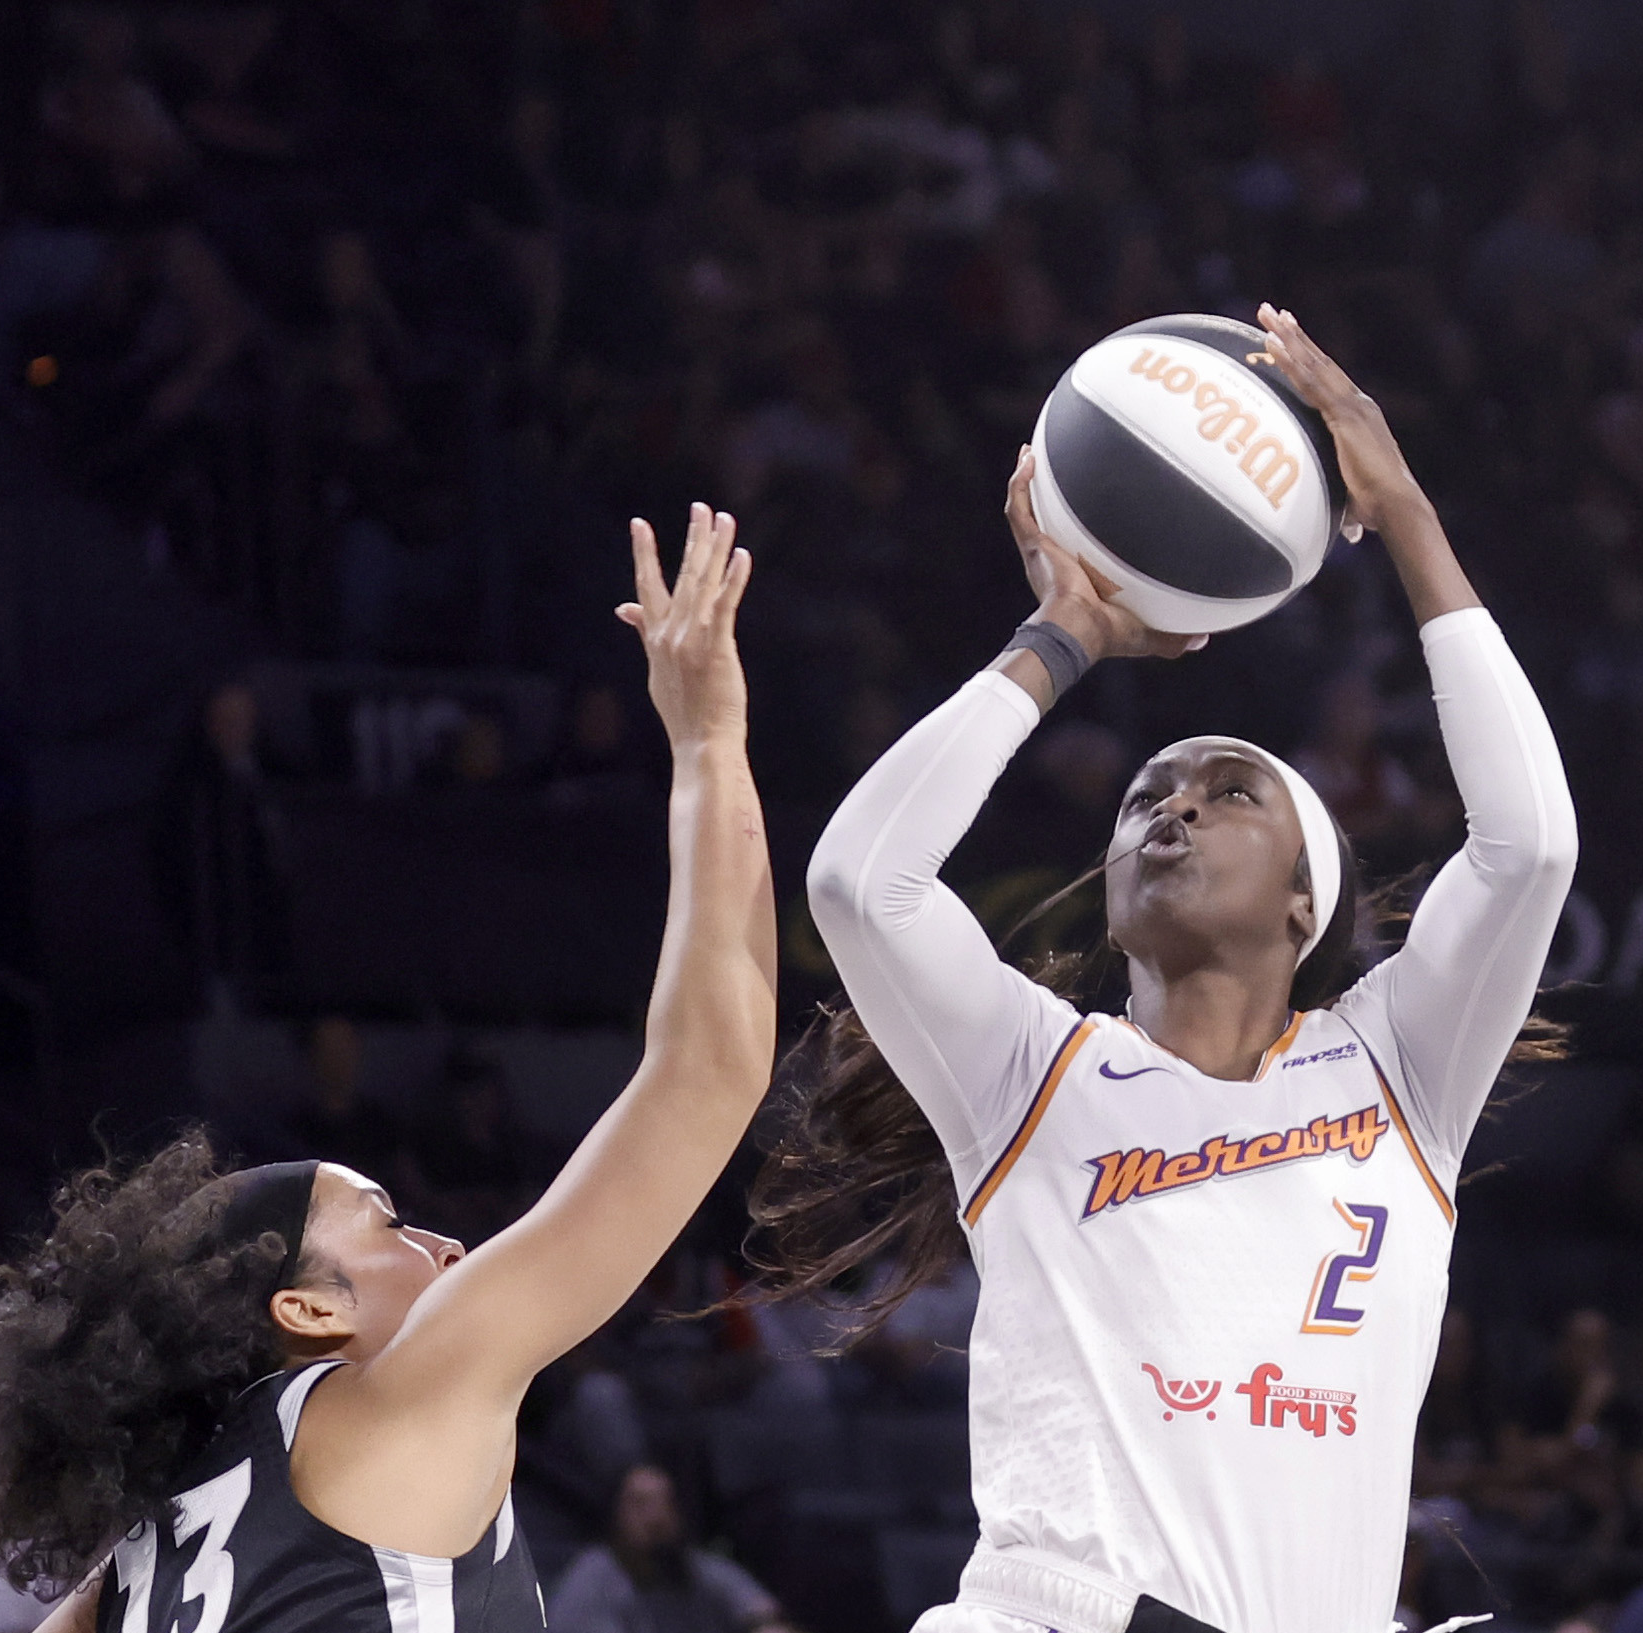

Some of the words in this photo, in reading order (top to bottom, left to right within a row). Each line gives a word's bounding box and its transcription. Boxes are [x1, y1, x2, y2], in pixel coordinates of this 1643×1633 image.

[1127, 348, 1300, 512] Wilson
[1080, 1103, 1390, 1222] Mercury
[1300, 1197, 1388, 1336] 2
[1235, 1362, 1357, 1438] fry's
[1269, 1385, 1305, 1398] FOOD
[1308, 1388, 1353, 1403] STORES
